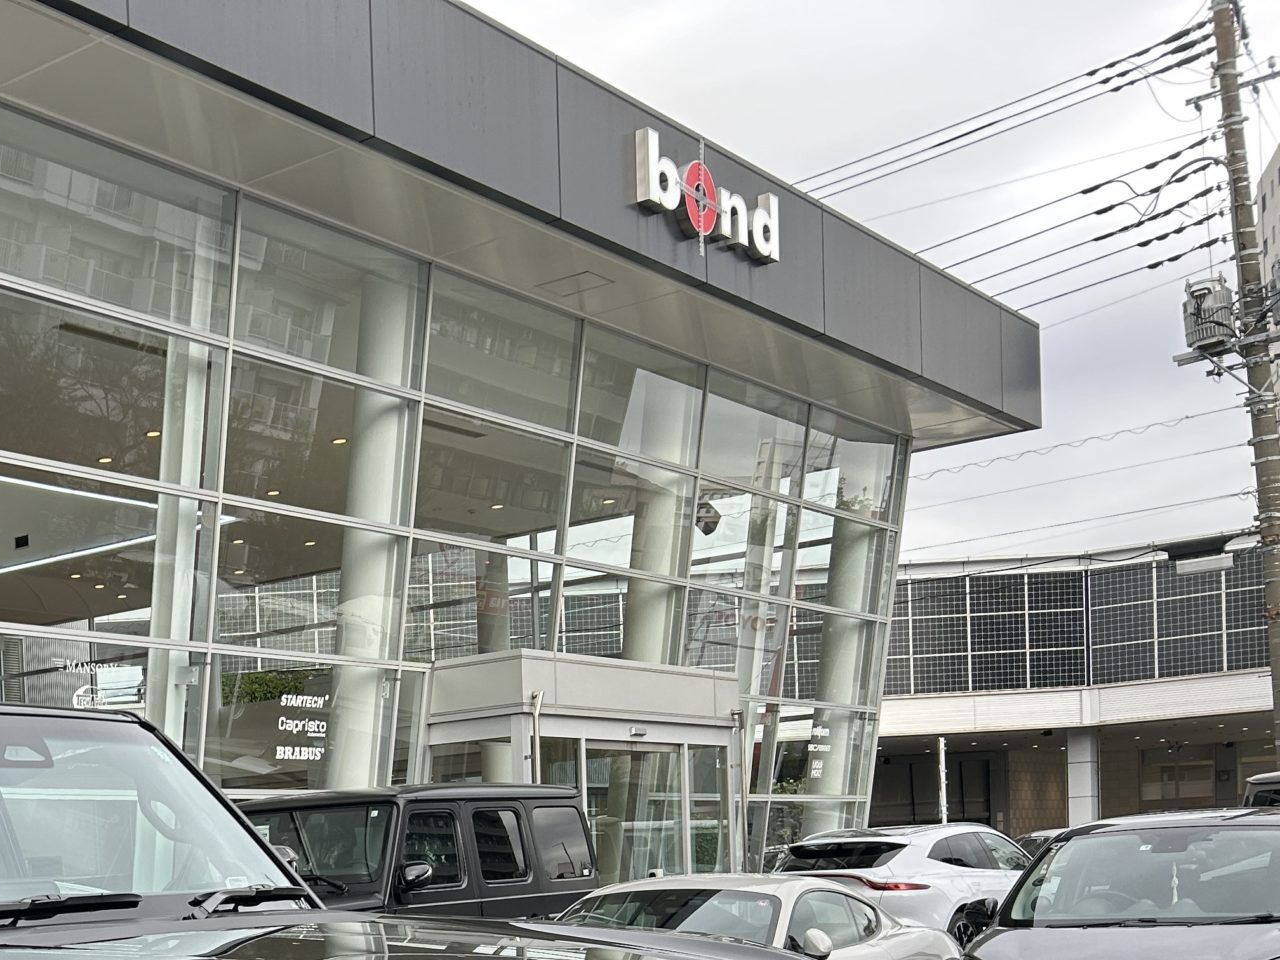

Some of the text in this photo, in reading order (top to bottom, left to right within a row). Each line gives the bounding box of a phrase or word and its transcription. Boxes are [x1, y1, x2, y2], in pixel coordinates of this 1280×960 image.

[635, 127, 780, 262] bond
[280, 694, 325, 708] STARTECH
[278, 716, 327, 734] Capristo
[275, 746, 322, 760] BRABUS
